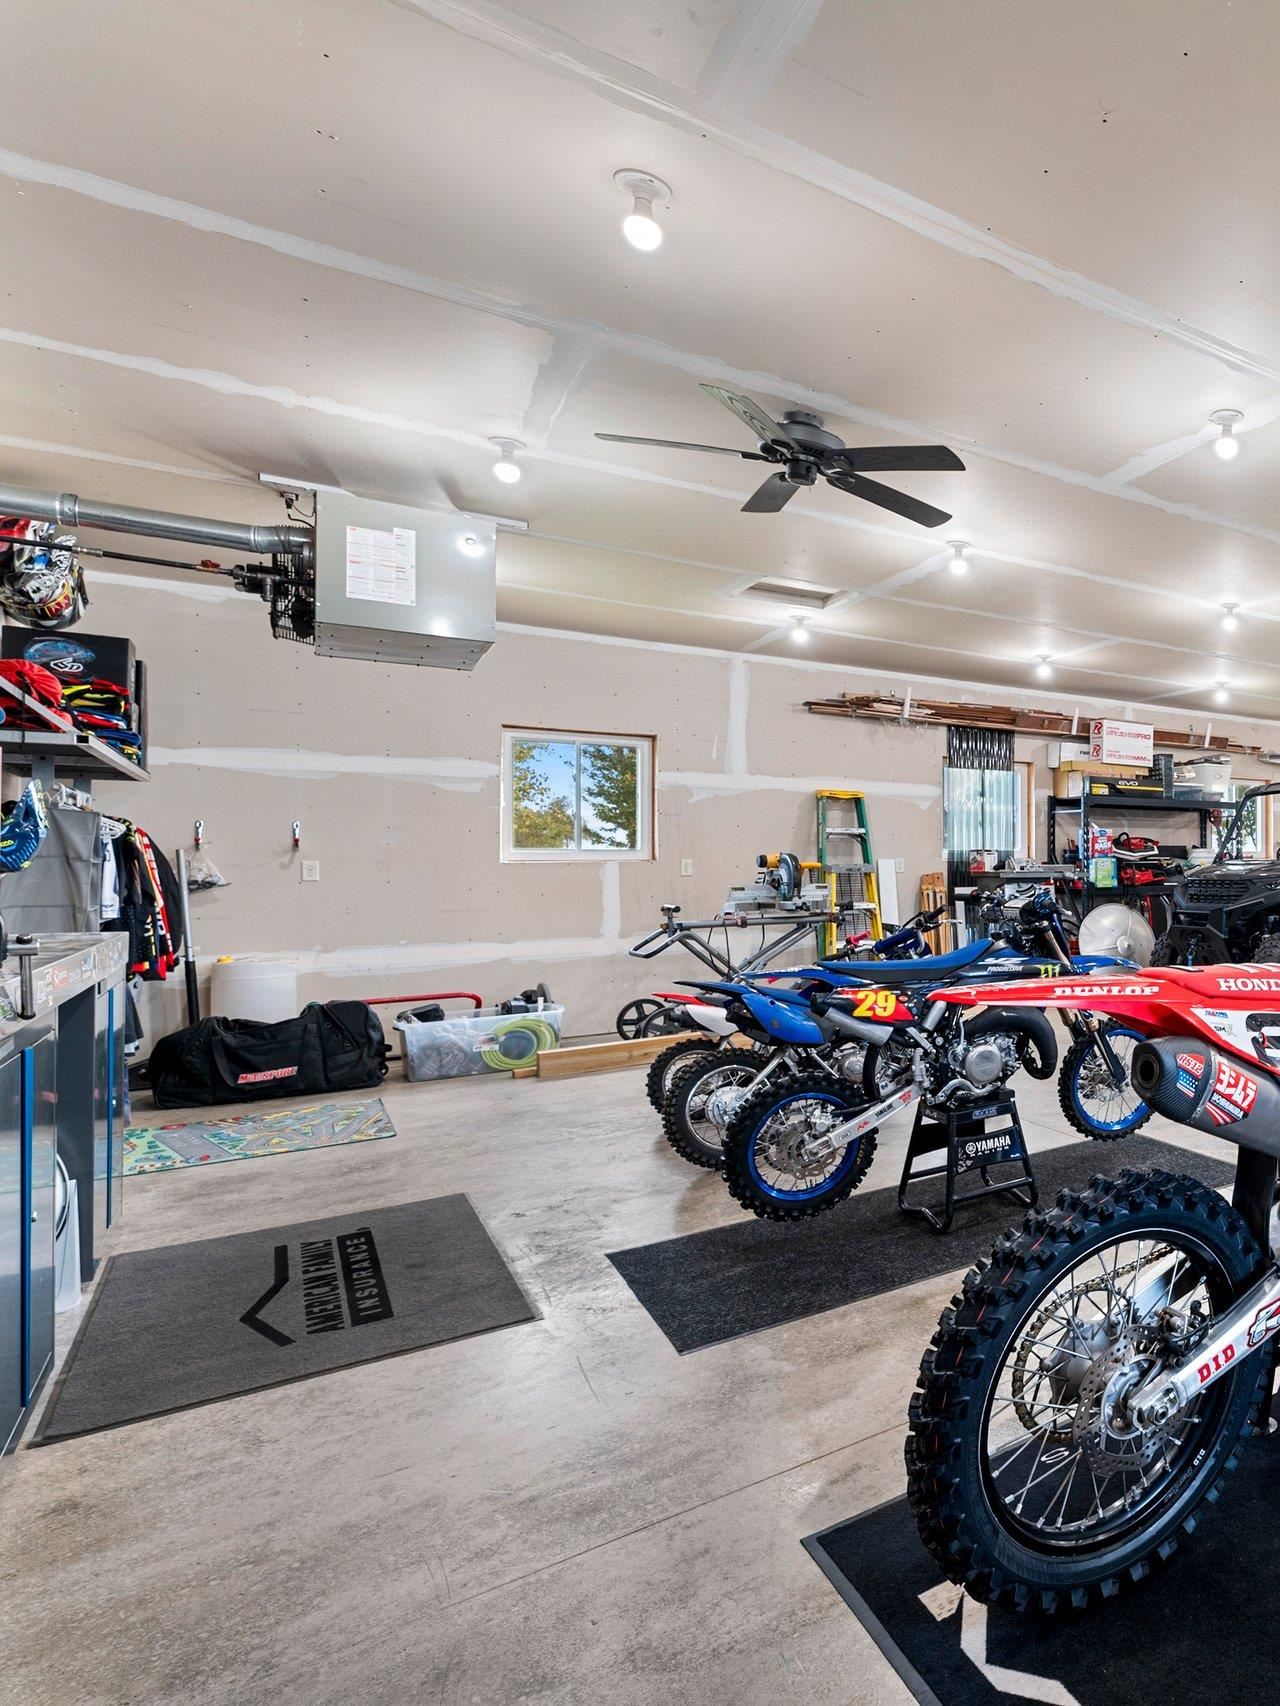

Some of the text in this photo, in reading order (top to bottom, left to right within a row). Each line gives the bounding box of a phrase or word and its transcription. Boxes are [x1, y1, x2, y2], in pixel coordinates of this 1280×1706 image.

[1054, 986, 1160, 996] DUNLOP
[853, 991, 897, 1017] 29
[970, 1146, 1010, 1158] RACING
[975, 1134, 1012, 1152] YAMAHA
[300, 1239, 345, 1335] AMERICAN FAMILY
[346, 1237, 382, 1316] INSURANCE
